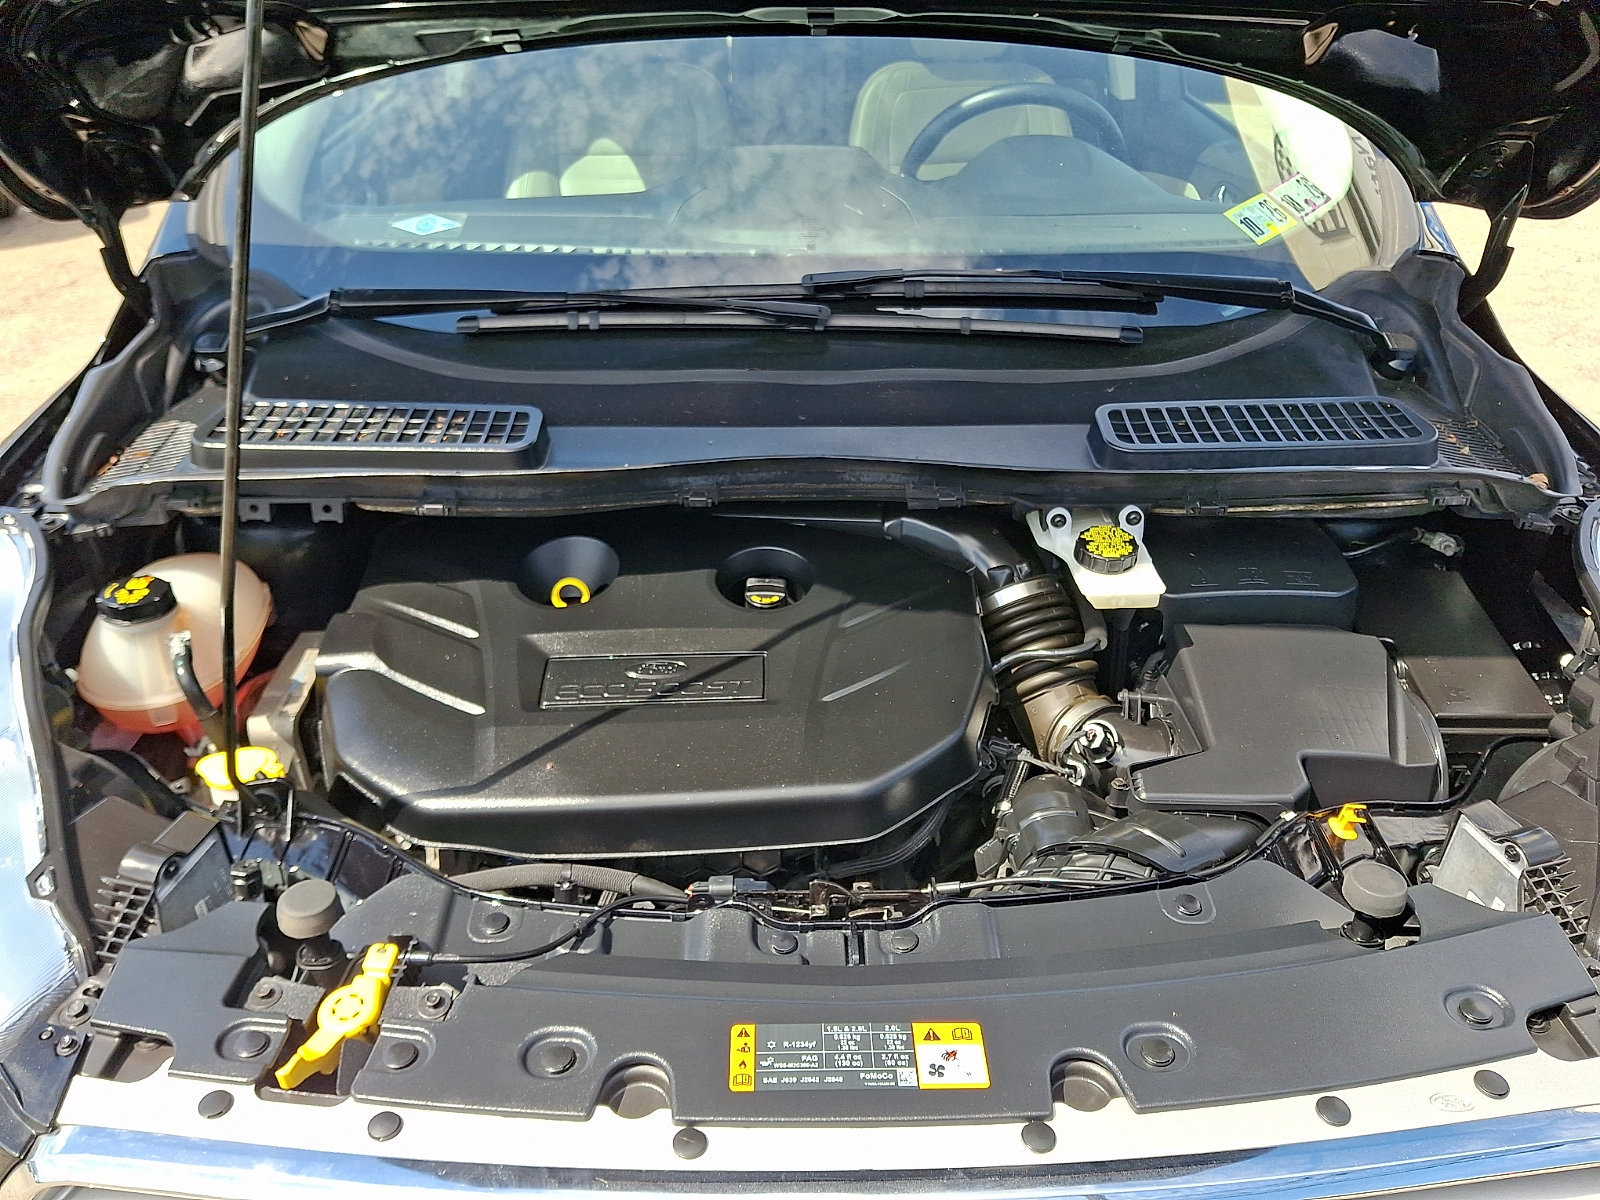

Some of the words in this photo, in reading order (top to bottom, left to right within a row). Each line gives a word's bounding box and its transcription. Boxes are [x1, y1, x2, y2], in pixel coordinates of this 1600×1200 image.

[1280, 194, 1305, 214] 10
[1239, 216, 1265, 238] 10
[1258, 199, 1288, 223] 26
[852, 1033, 861, 1041] kg
[898, 1033, 907, 1041] kg
[783, 1040, 816, 1049] R-1234yf
[801, 1054, 818, 1062] PAG
[859, 1072, 894, 1080] FoMoCo
